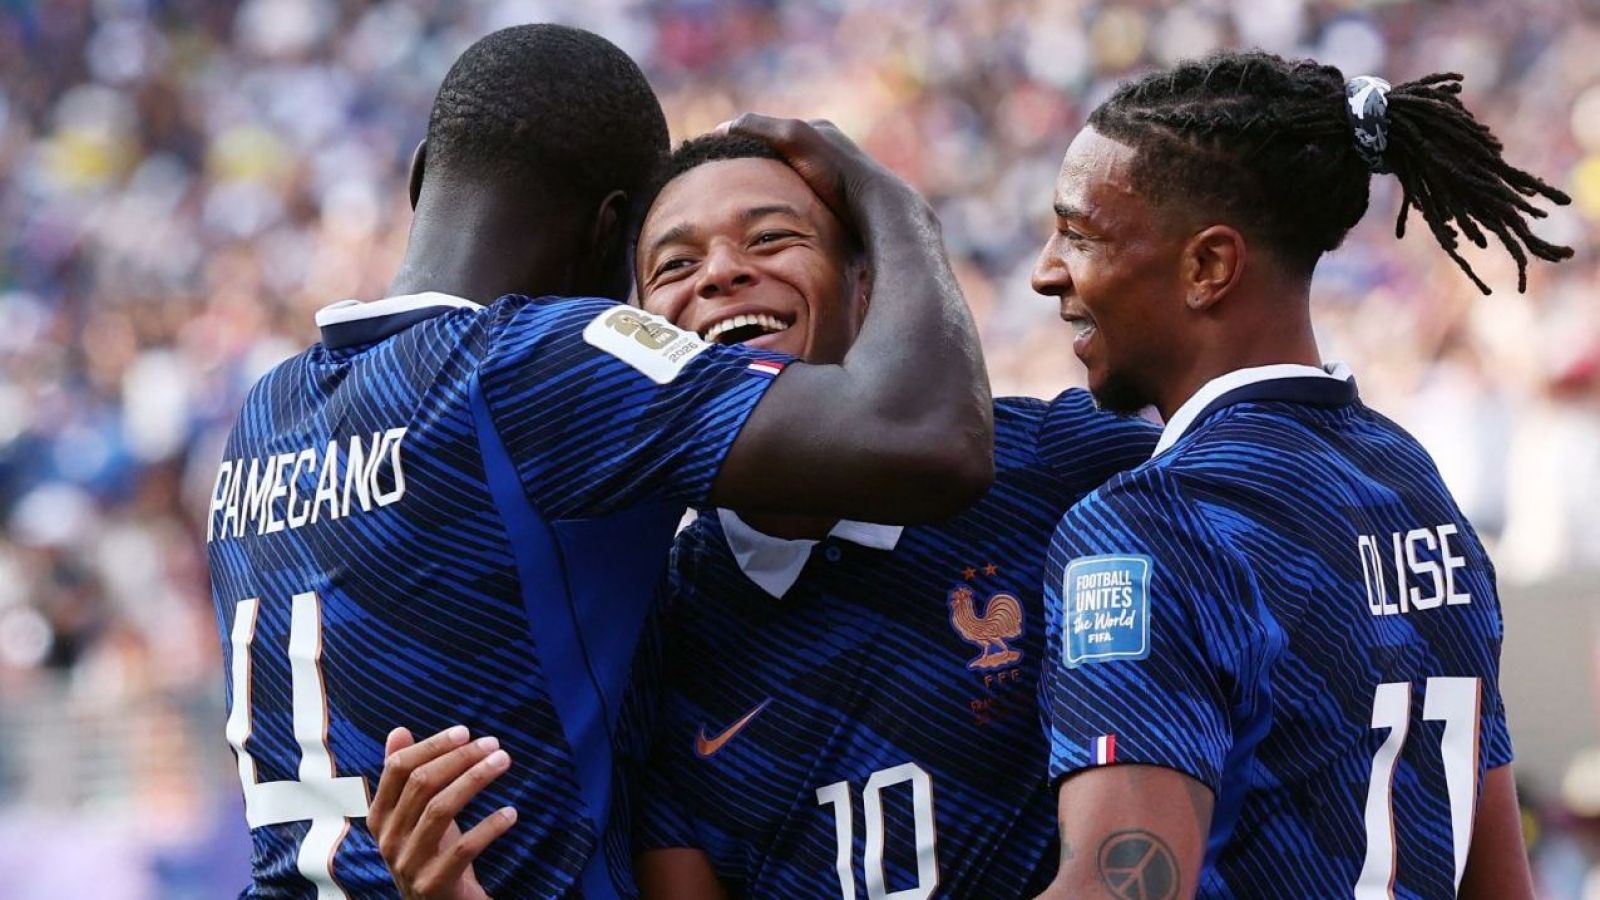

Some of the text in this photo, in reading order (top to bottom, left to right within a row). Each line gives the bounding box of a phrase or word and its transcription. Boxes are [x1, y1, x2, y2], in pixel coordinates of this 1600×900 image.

[1076, 570, 1132, 591] FOOTBALL
[1076, 586, 1133, 613] UNITES
[1358, 523, 1471, 616] OLISE
[1073, 608, 1136, 634] the World
[1088, 632, 1112, 644] FIFA
[226, 591, 371, 900] 4
[1354, 676, 1482, 900] 11
[815, 762, 940, 900] 10
